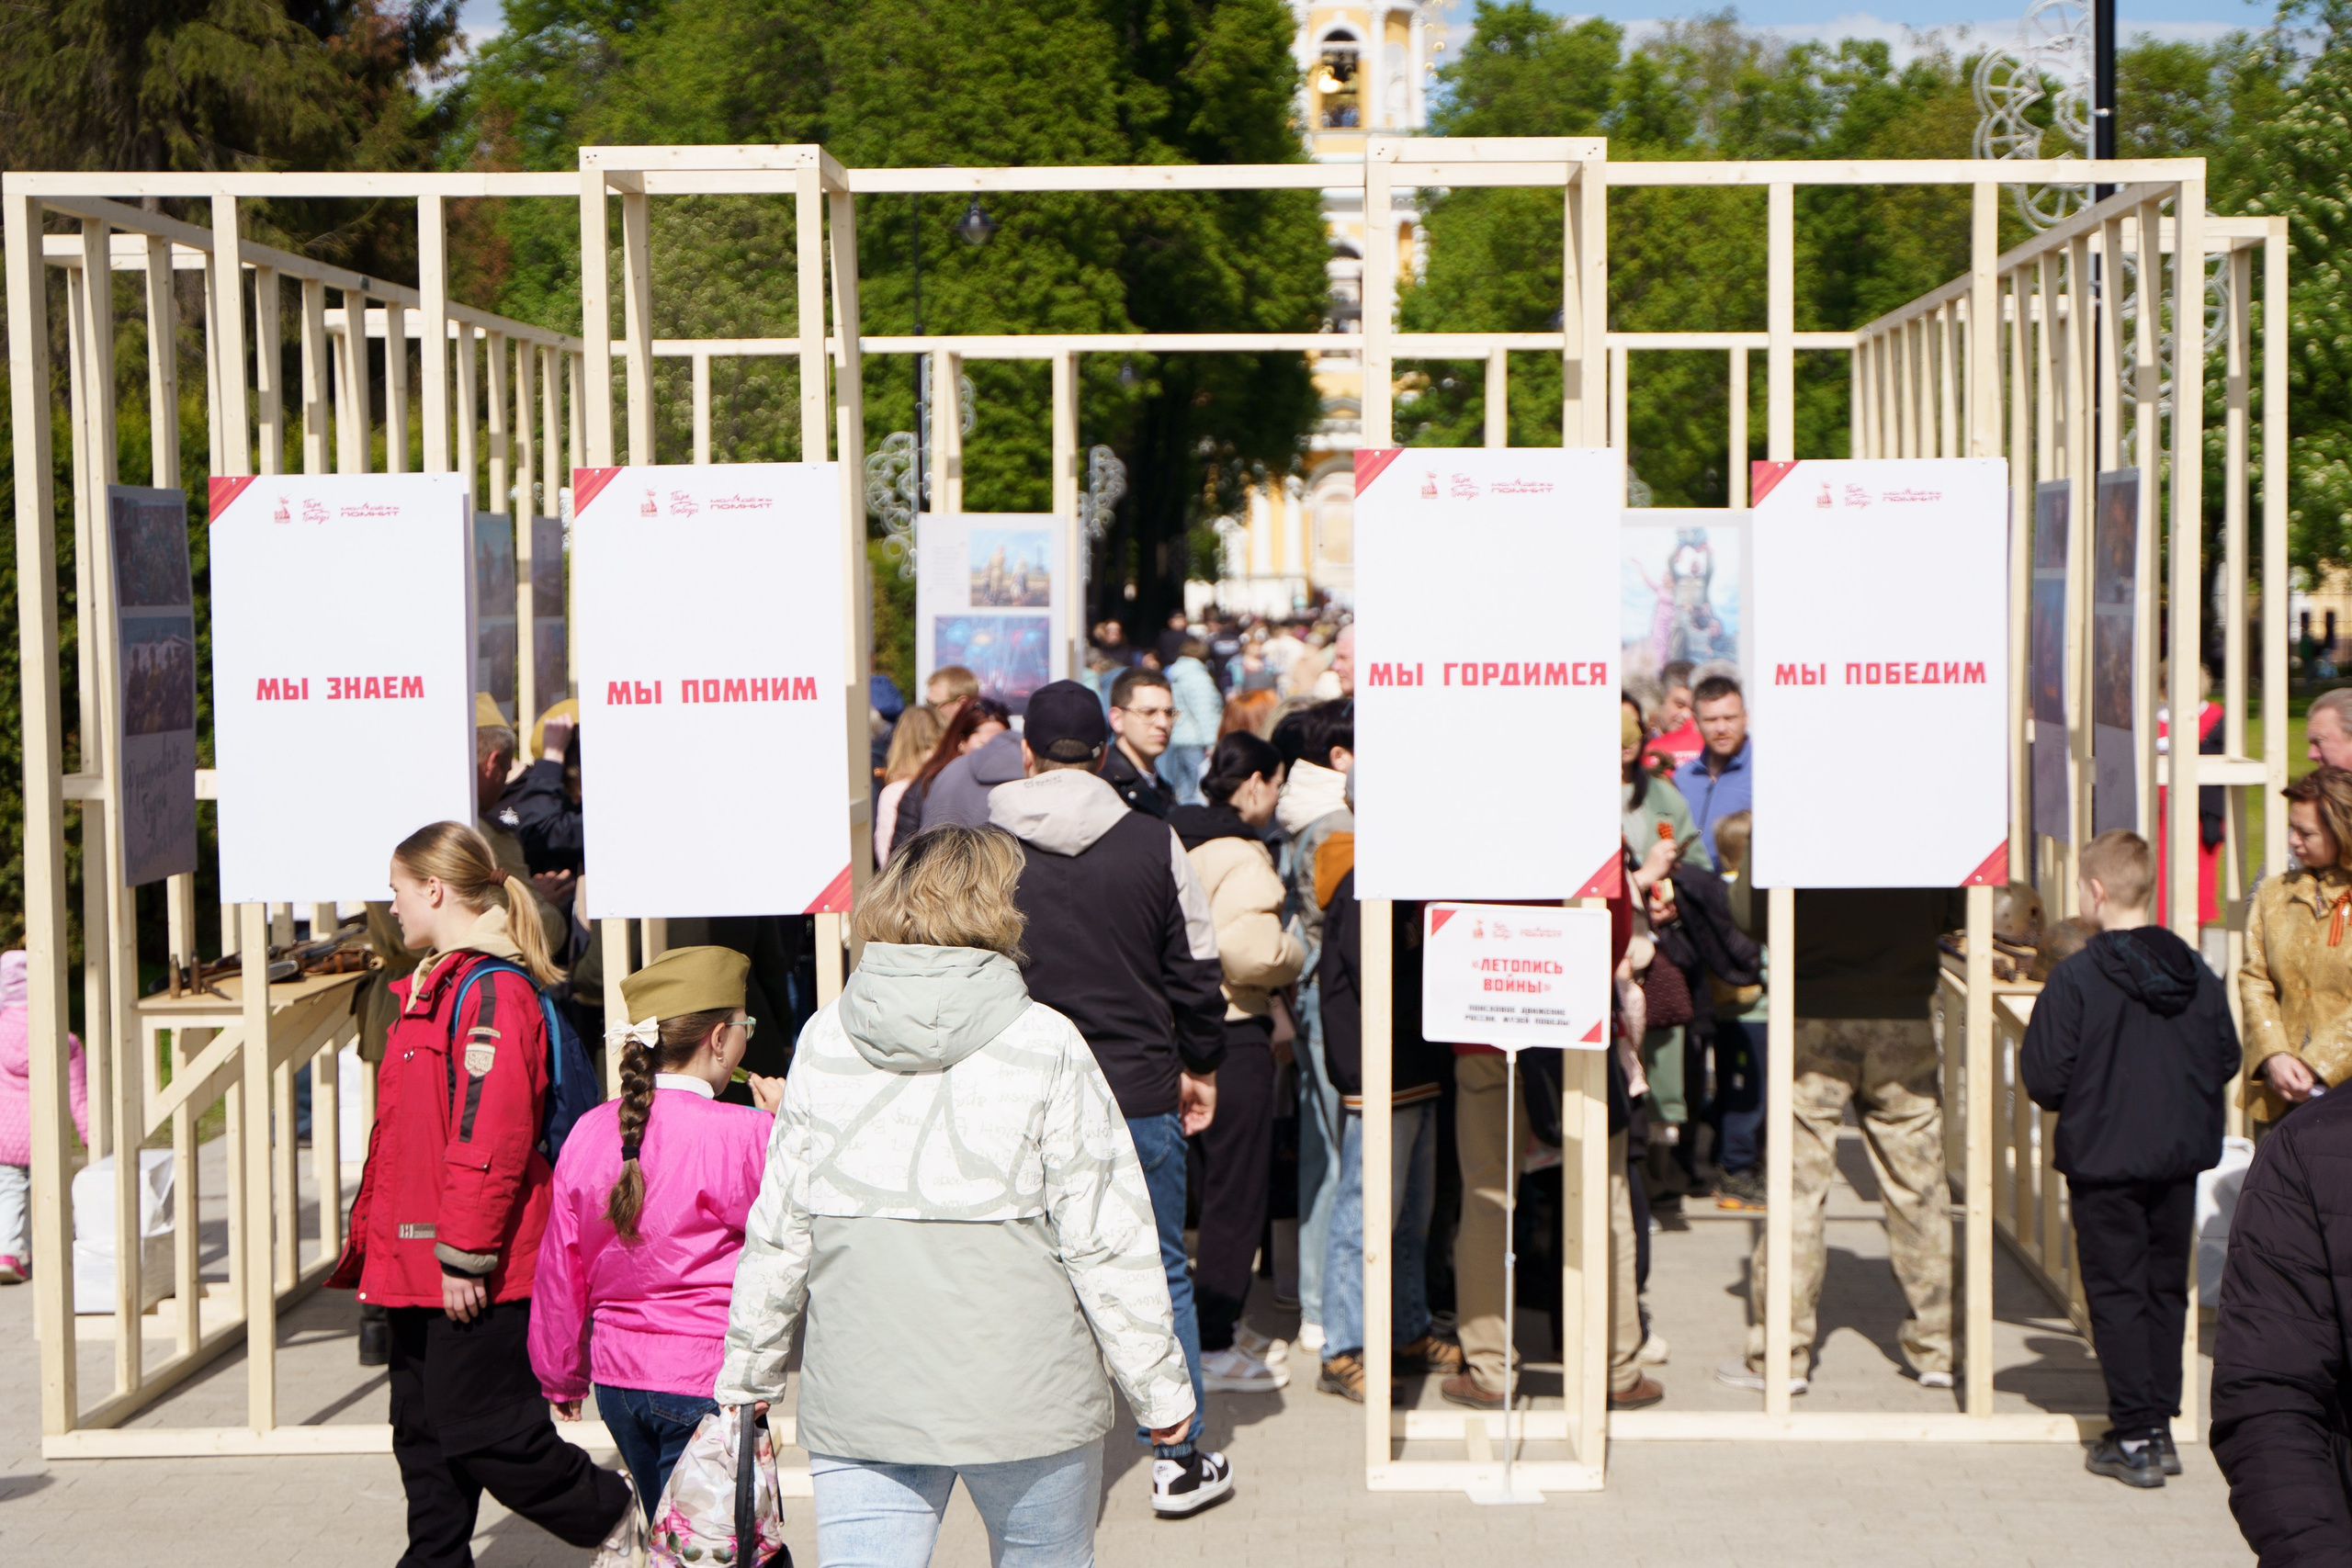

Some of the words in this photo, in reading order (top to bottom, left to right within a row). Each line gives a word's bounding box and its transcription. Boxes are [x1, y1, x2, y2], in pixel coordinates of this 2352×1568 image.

[1368, 662, 1423, 686] МЫ
[1443, 661, 1607, 686] ГОРДИМСЯ
[1775, 662, 1826, 685] МЫ
[1845, 661, 1987, 685] ПОБЕДИМ
[256, 677, 309, 701] МЫ
[326, 675, 424, 700] ЗНАЕМ
[606, 680, 662, 705] МЫ
[682, 676, 818, 704] ПОМНИМ
